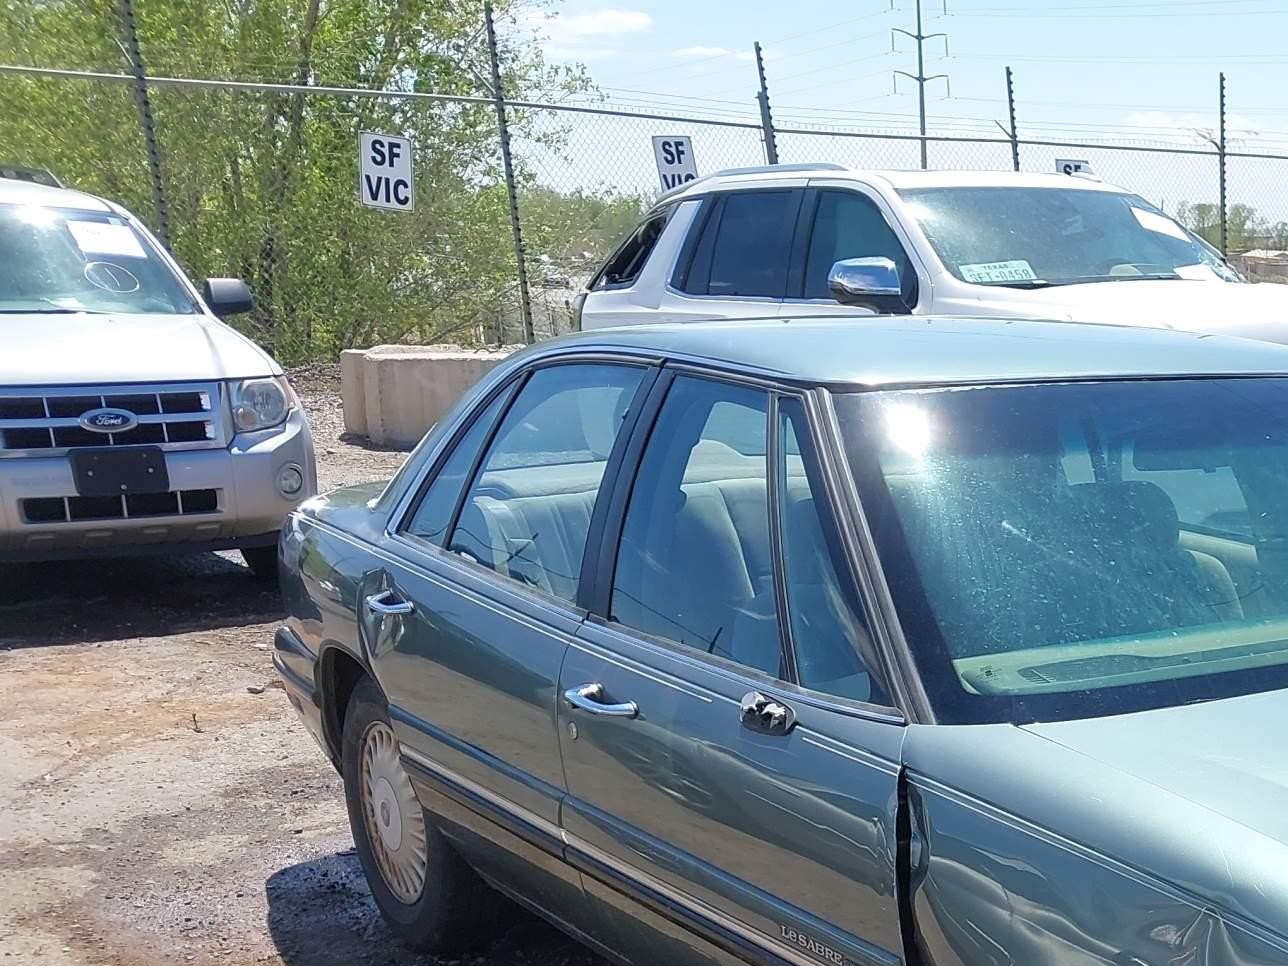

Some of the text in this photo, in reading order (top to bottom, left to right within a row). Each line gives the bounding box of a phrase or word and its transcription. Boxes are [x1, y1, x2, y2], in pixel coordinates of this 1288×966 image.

[370, 138, 402, 168] SF
[661, 140, 686, 165] SF
[364, 173, 410, 206] VIC
[95, 414, 123, 426] Ford
